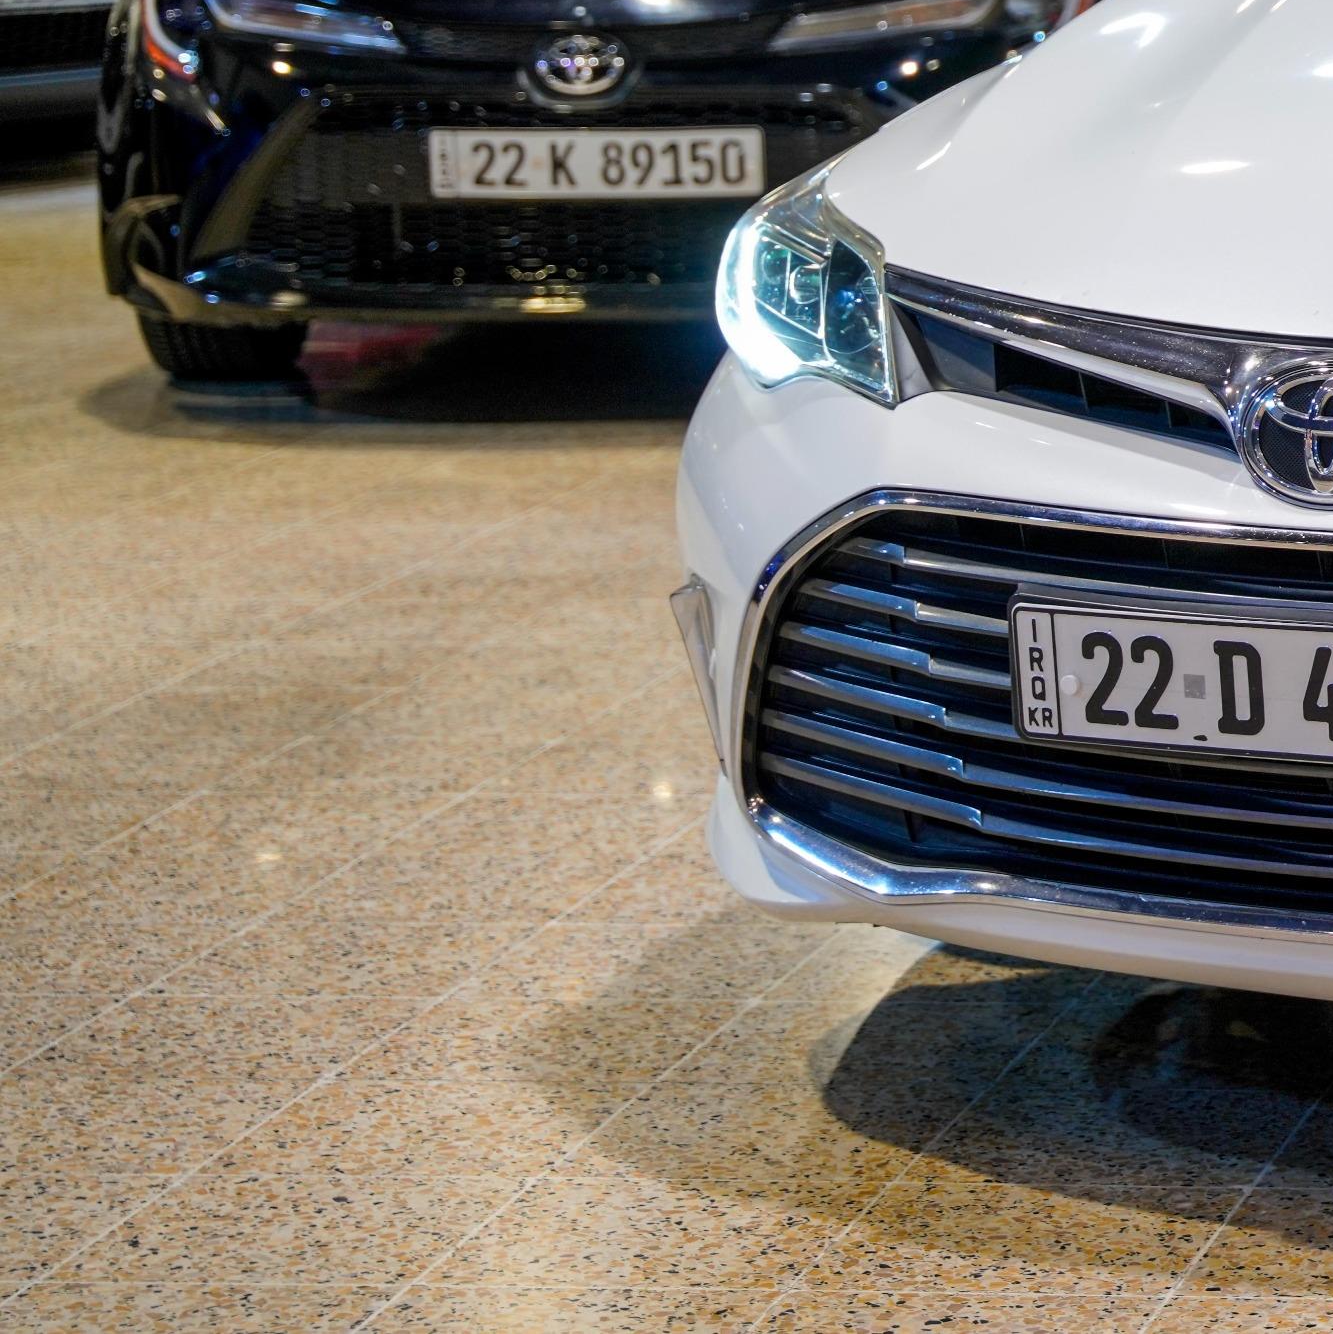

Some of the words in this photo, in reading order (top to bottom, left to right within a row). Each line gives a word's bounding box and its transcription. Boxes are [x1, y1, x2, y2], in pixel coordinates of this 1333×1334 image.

[471, 141, 527, 188] 22
[549, 143, 577, 187] K
[600, 140, 747, 188] 89150
[1081, 631, 1180, 731] 22
[1213, 640, 1266, 736] D
[1028, 706, 1053, 729] KR
